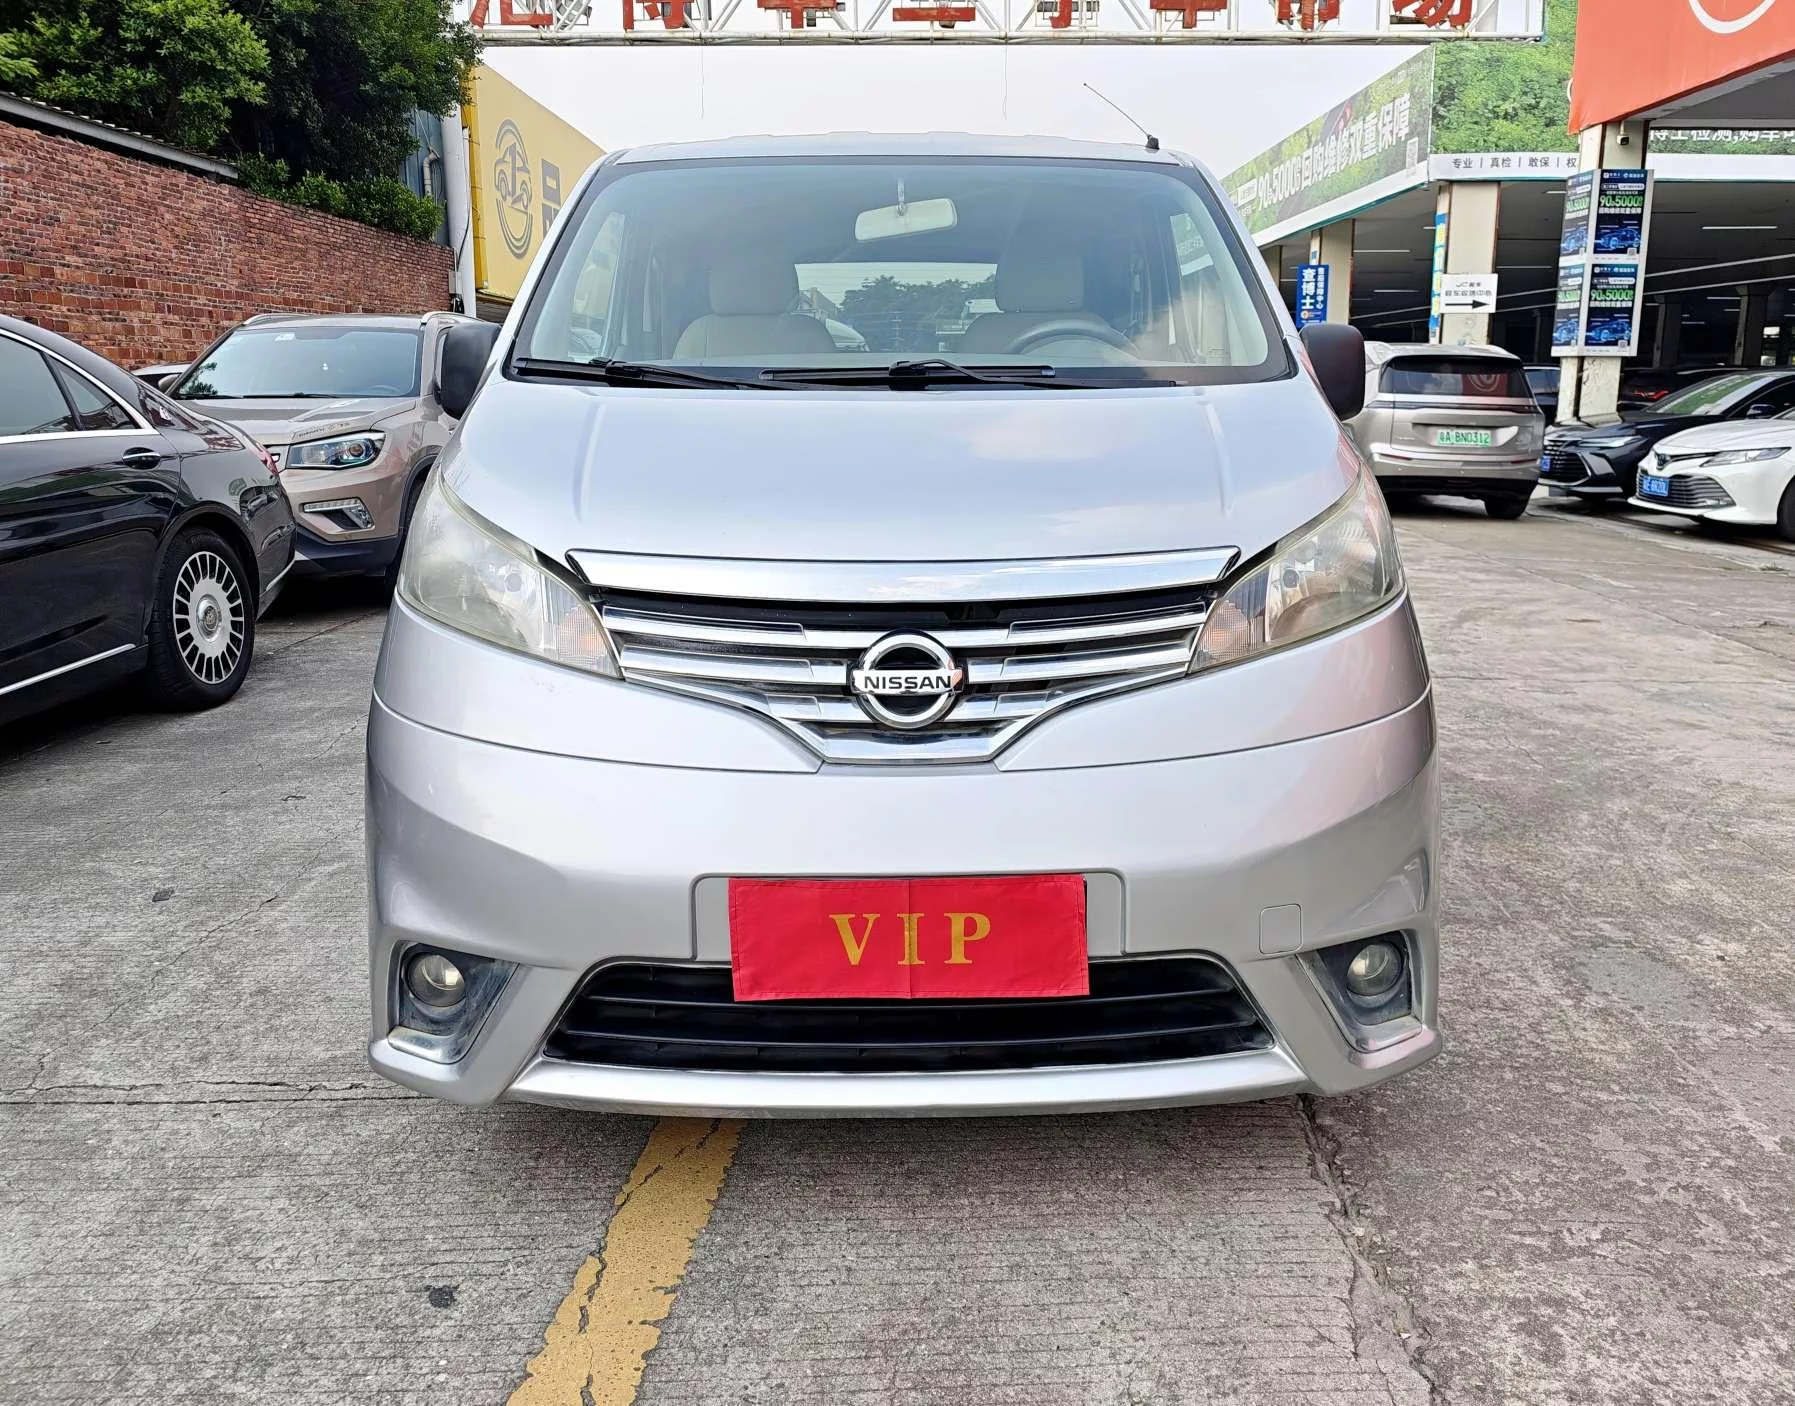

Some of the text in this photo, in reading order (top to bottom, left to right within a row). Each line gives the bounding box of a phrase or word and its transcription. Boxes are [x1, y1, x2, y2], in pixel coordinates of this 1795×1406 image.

[1452, 157, 1473, 168] 专业
[1490, 157, 1511, 168] 真检
[1528, 156, 1550, 168] 敢保
[864, 676, 951, 690] NISSAN
[829, 912, 991, 966] VIP
